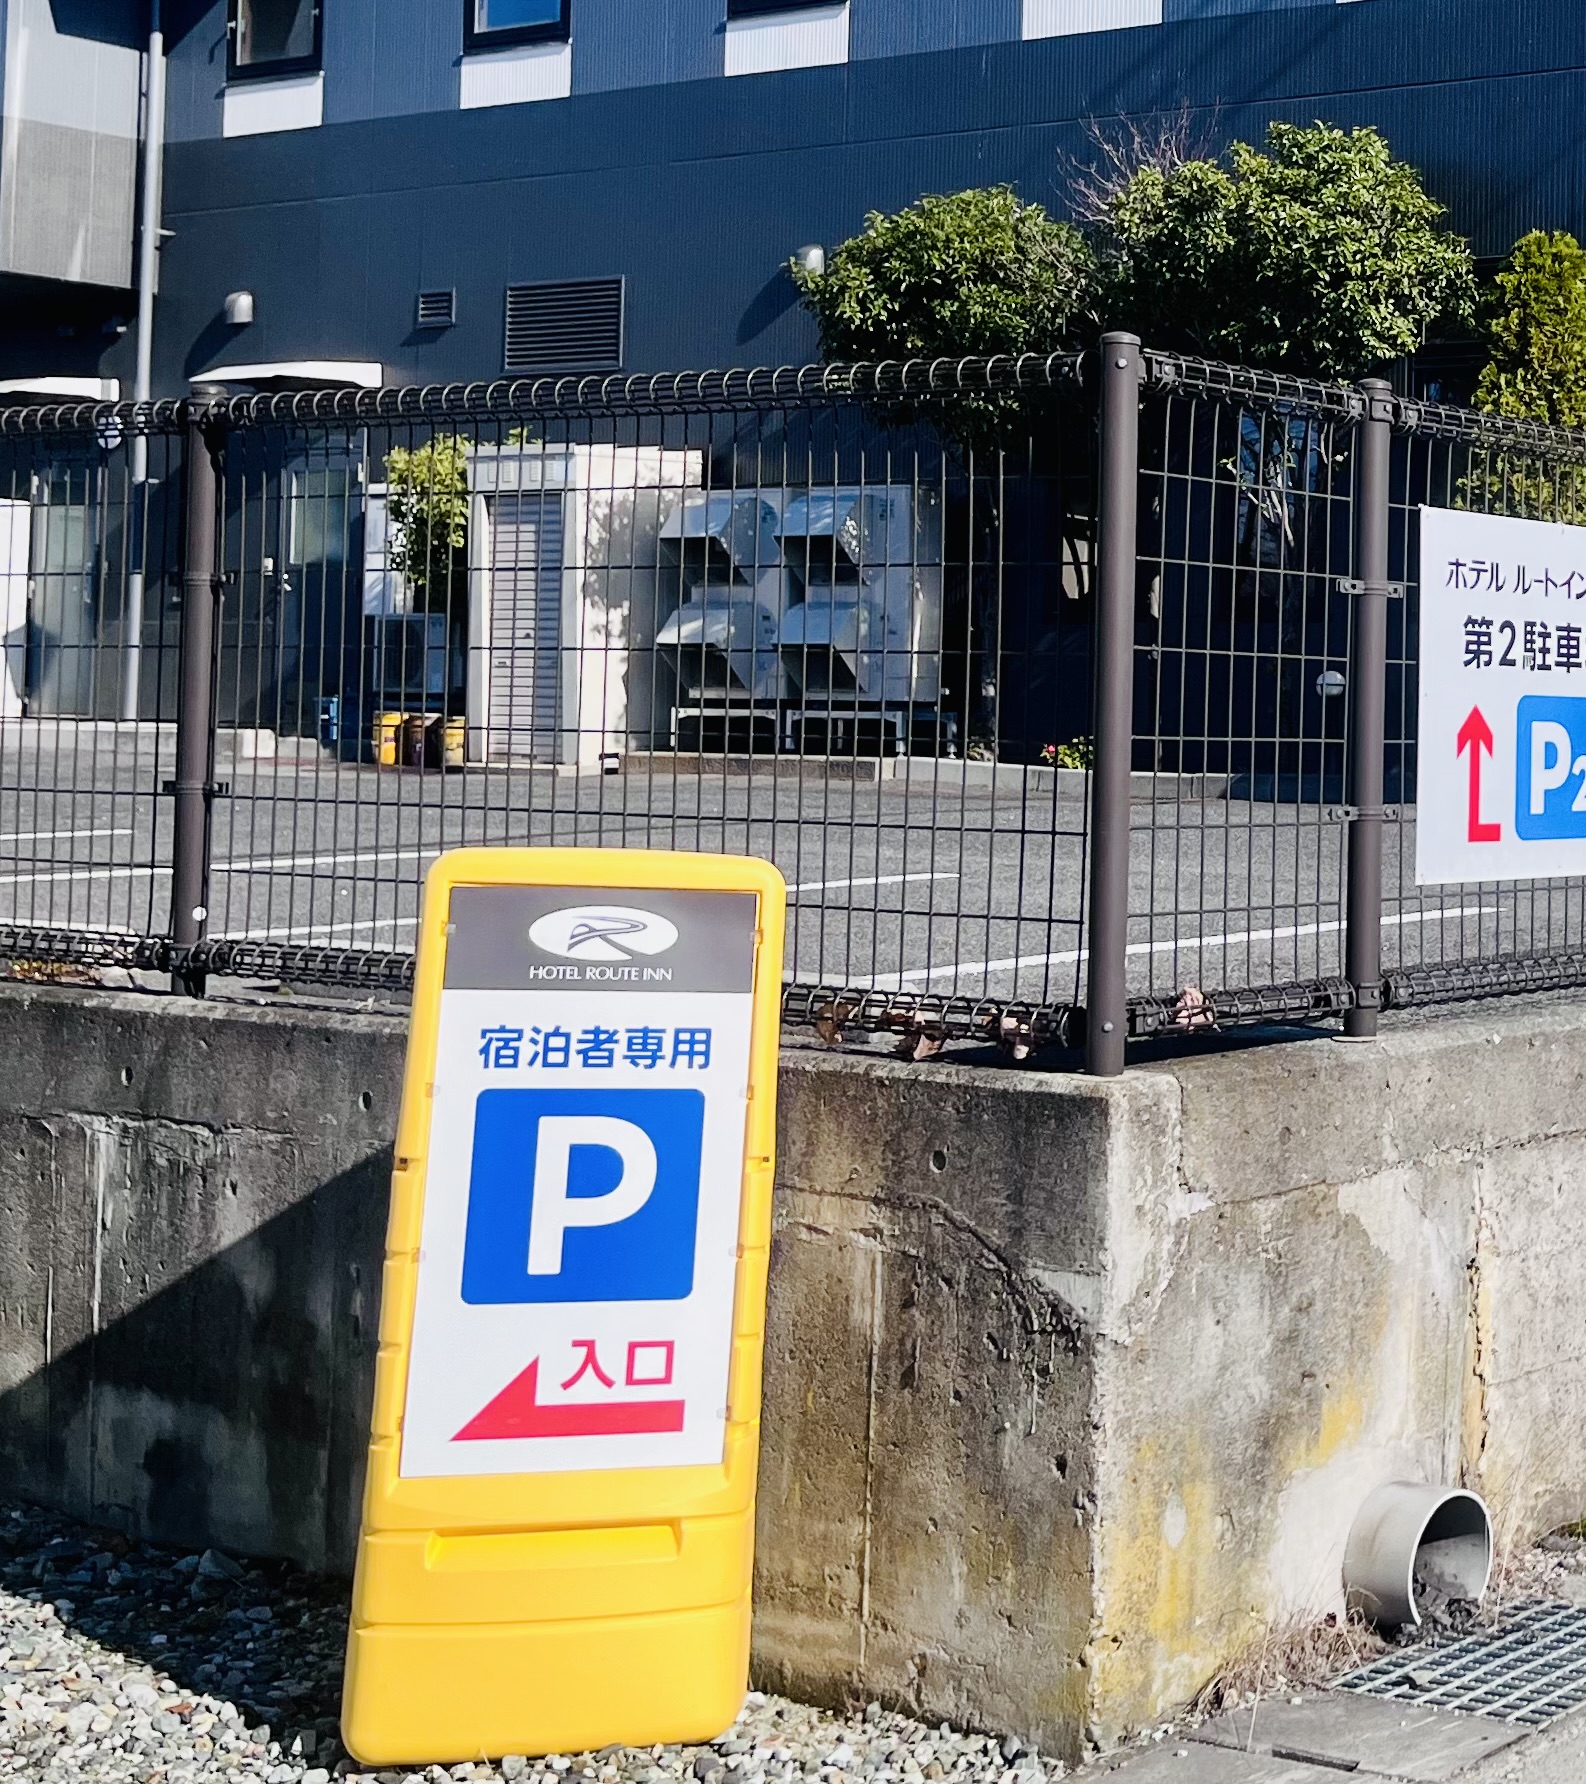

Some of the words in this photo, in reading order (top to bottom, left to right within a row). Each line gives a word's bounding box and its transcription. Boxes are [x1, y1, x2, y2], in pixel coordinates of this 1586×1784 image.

[1446, 558, 1506, 592] ホテル
[529, 965, 582, 980] HOTEL
[586, 966, 639, 981] ROUTE
[643, 967, 672, 981] INN
[478, 1025, 713, 1071] 宿泊者専用
[527, 1115, 658, 1276] P
[560, 1339, 676, 1391] 入口
